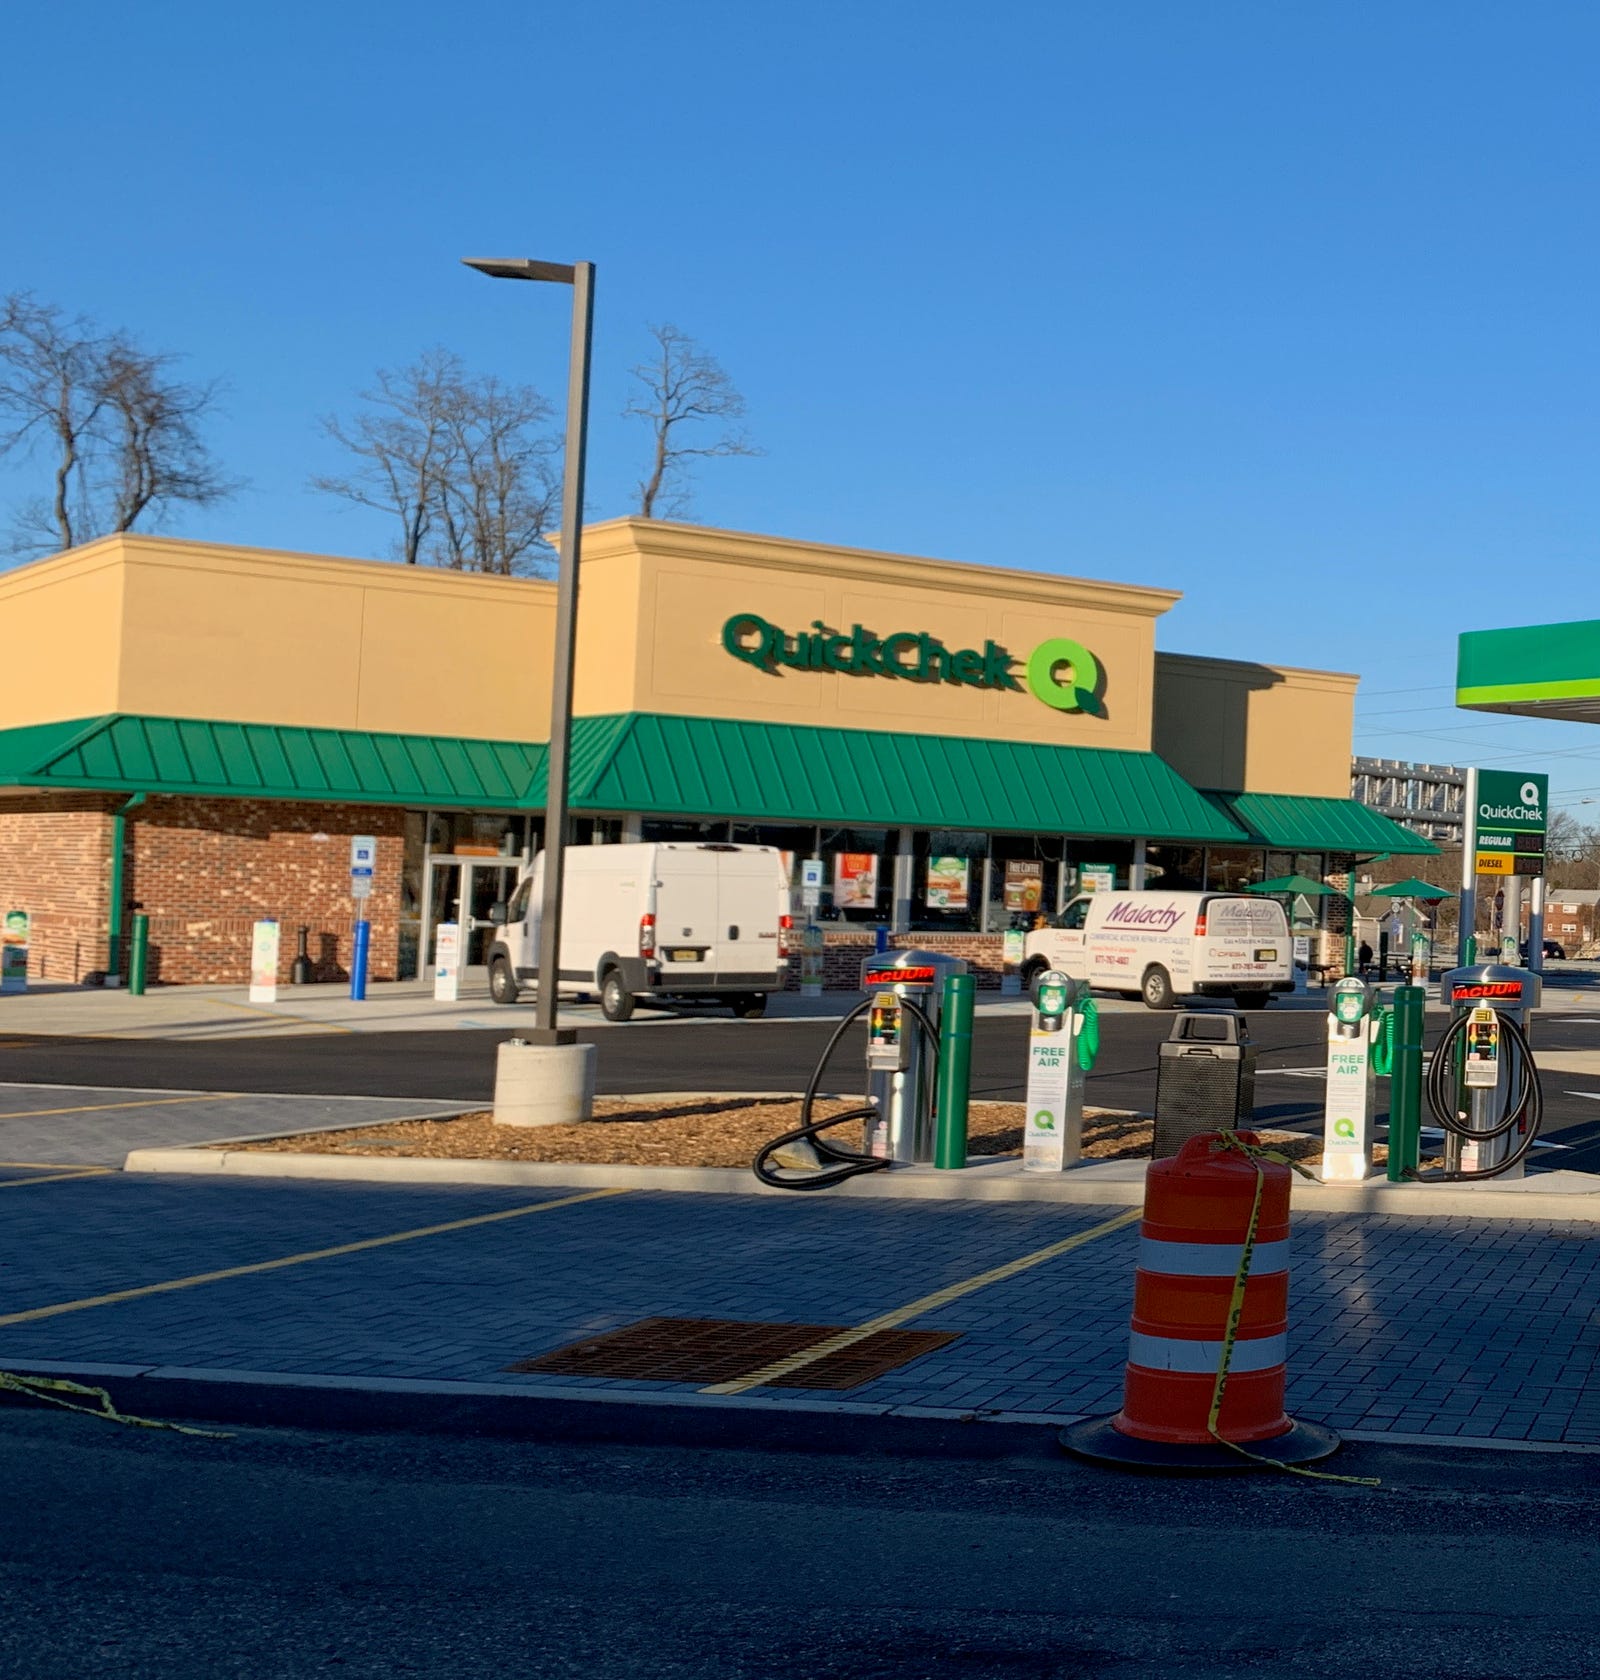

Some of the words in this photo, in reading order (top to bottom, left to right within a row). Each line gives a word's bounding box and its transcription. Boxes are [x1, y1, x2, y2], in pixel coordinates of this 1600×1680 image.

[722, 612, 1015, 687] QuickChek
[1480, 803, 1543, 821] QuickChek
[1478, 835, 1513, 846] REGULAR
[1478, 858, 1504, 868] DIESEL
[1105, 901, 1186, 926] Malachy
[865, 966, 936, 985] VACUUM
[1452, 982, 1524, 1000] VACUUM
[1033, 1047, 1065, 1056] FREE
[1038, 1058, 1060, 1067] AIR
[1332, 1055, 1364, 1064] FREE
[1336, 1065, 1359, 1075] AIR
